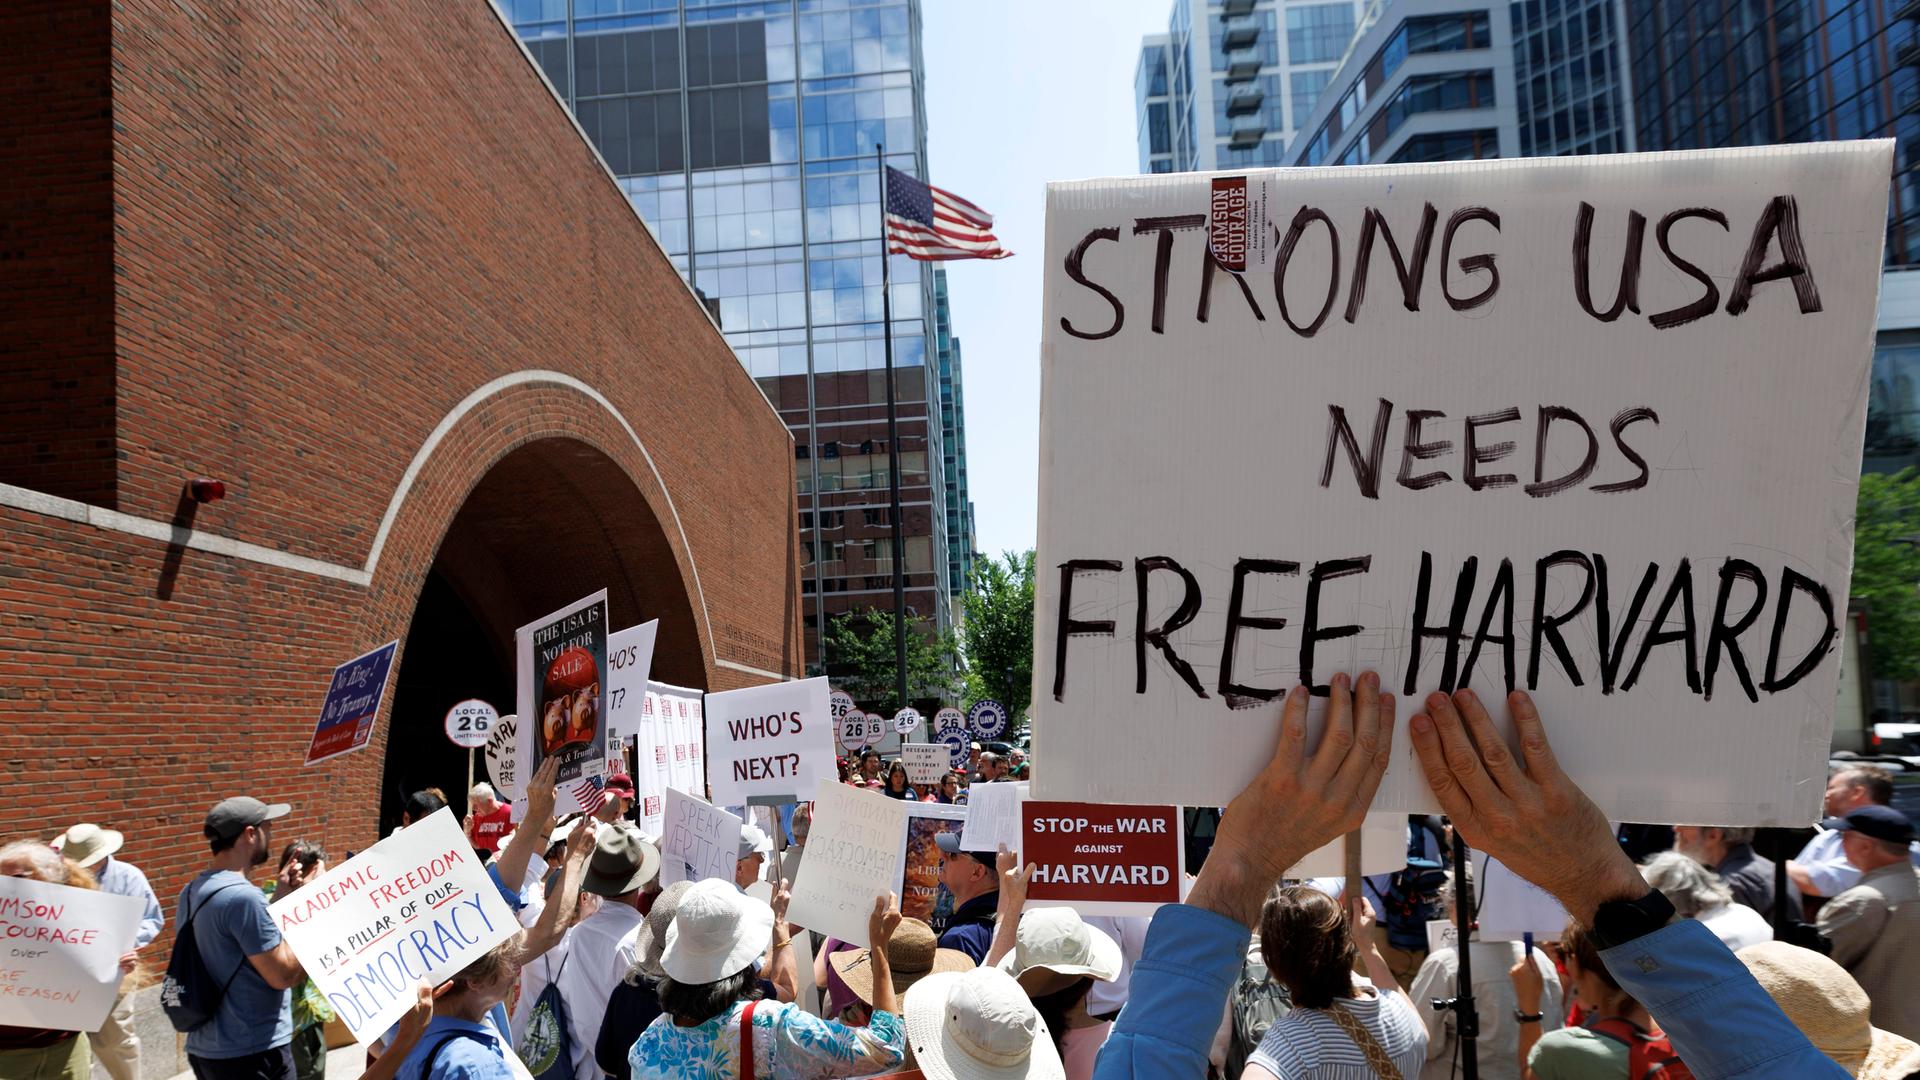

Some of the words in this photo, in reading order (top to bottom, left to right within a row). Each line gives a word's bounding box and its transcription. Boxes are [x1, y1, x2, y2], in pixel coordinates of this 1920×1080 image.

[1212, 190, 1229, 263] CRIMSON
[1229, 187, 1246, 264] COURAGE
[1060, 202, 1503, 340] STRONG
[1574, 196, 1823, 329] USA
[1320, 397, 1660, 499] NEEDS
[536, 625, 560, 646] THE
[562, 612, 585, 634] USA
[588, 605, 599, 621] IS
[1053, 555, 1371, 710] FREE
[1404, 550, 1839, 703] HARVARD
[541, 643, 566, 665] NOT
[568, 631, 593, 652] FOR
[608, 645, 637, 671] HO'S
[552, 658, 582, 681] SALE
[458, 716, 488, 731] 26
[831, 703, 847, 717] 26
[898, 716, 914, 726] 26
[940, 718, 959, 729] 26
[487, 720, 517, 759] HARV
[728, 711, 803, 742] WHO'S
[845, 723, 863, 737] 26
[572, 746, 596, 761] Trump
[733, 752, 800, 782] NEXT?
[499, 771, 515, 786] FRE
[680, 799, 723, 839] SPEAK
[1033, 817, 1089, 833] STOP
[1091, 824, 1114, 833] THE
[1116, 818, 1166, 833] WAR
[1074, 844, 1123, 853] AGAINST
[368, 850, 464, 910] FREEDOM
[1031, 864, 1170, 885] HARVARD
[281, 865, 381, 931] ACADEMIC
[912, 886, 940, 897] NOT
[0, 897, 65, 921] MSON
[319, 953, 334, 970] IS
[335, 946, 347, 959] A
[348, 915, 397, 951] PILLAR
[400, 900, 418, 919] OF
[425, 881, 459, 905] OUR
[10, 948, 48, 959] over
[328, 893, 494, 1033] DEMOCRACY
